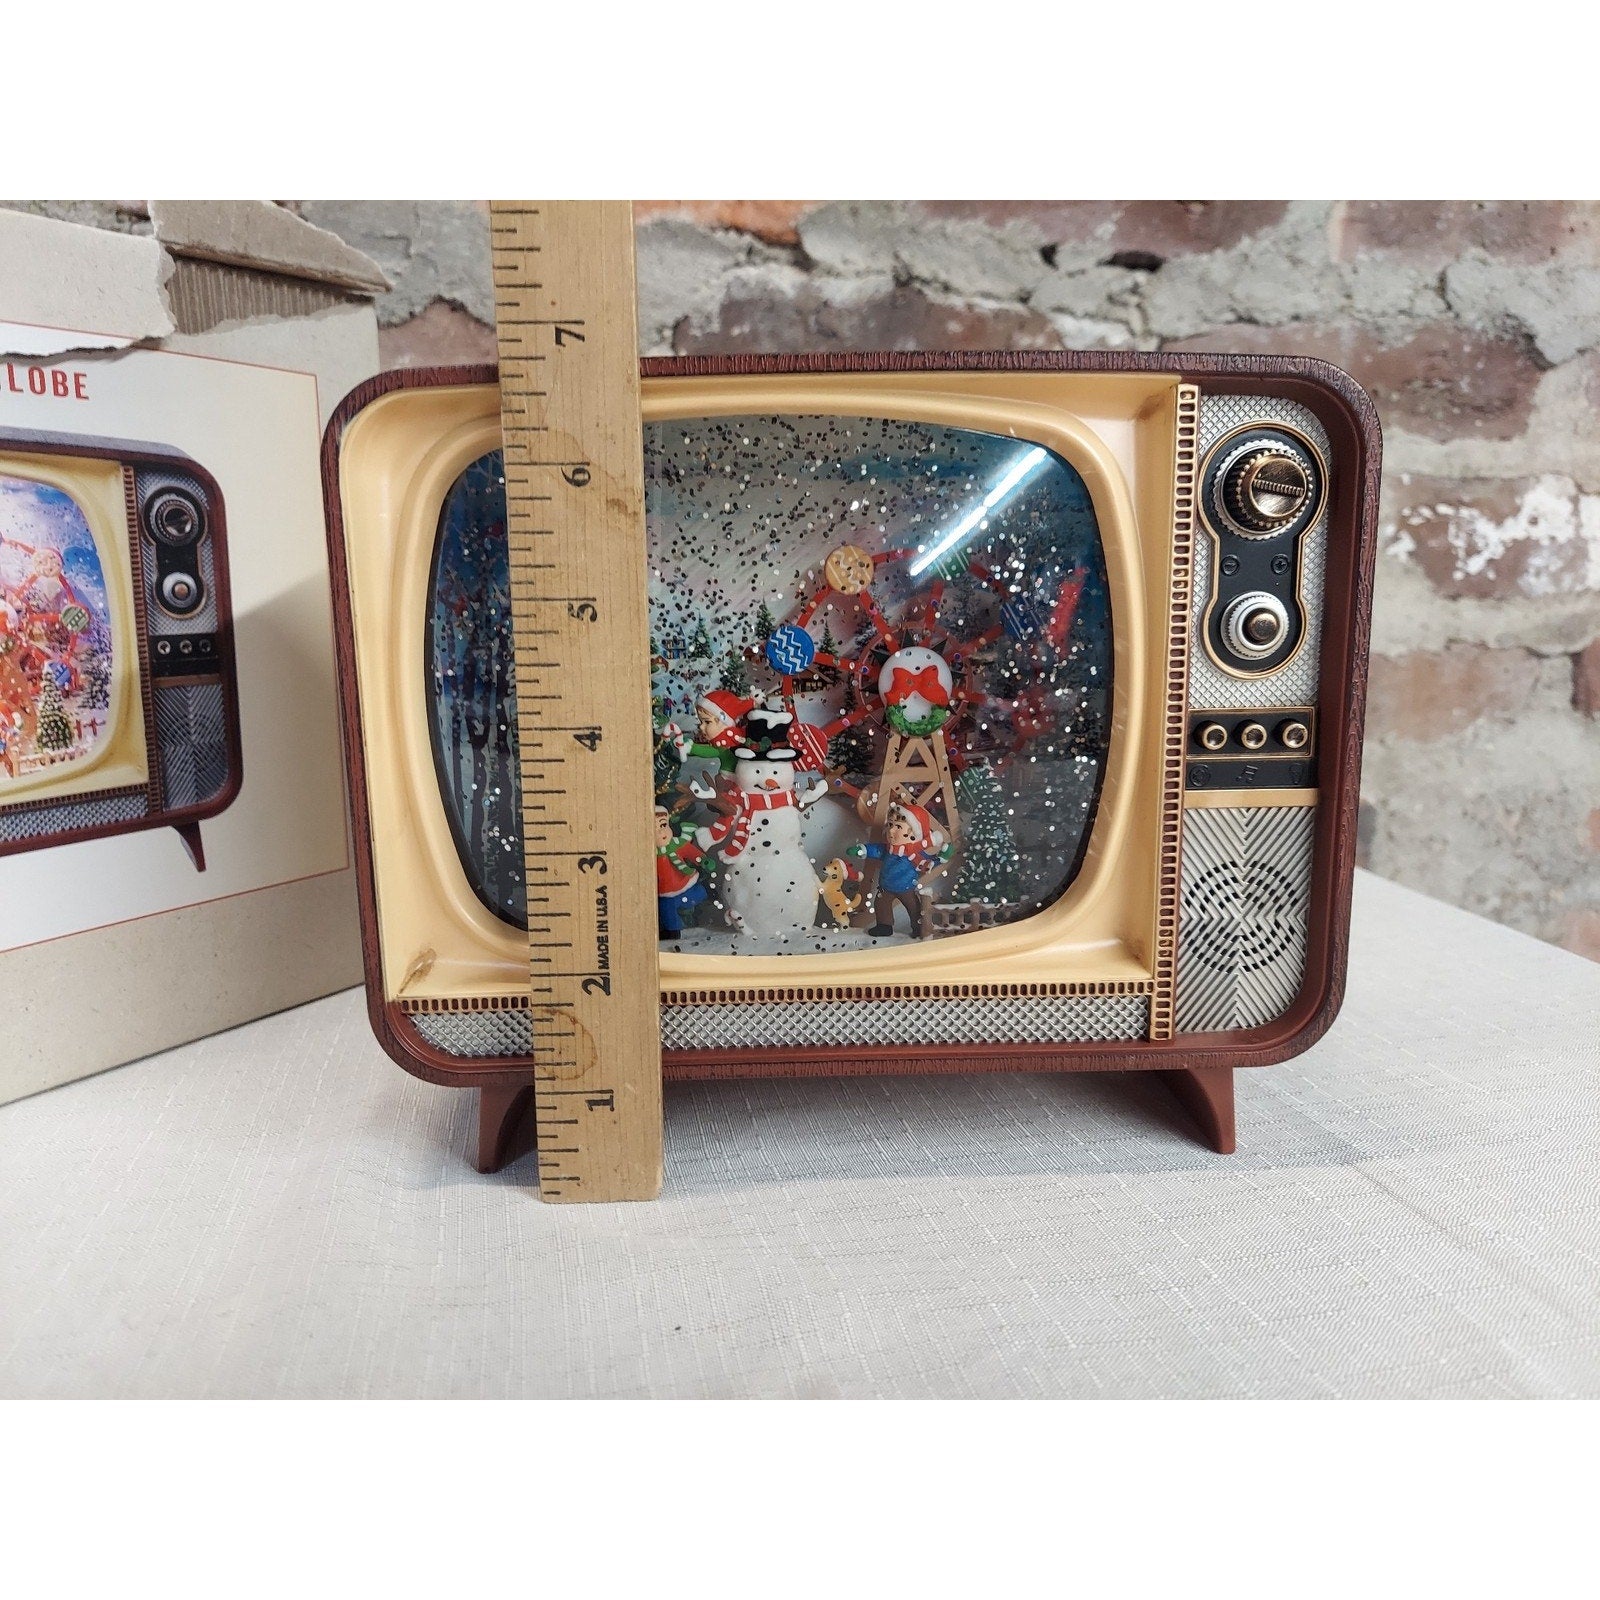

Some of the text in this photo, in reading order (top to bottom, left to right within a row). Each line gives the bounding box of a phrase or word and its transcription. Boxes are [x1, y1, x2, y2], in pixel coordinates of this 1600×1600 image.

[554, 326, 586, 348] 7
[0, 362, 90, 400] LOBE
[561, 466, 592, 487] 6
[566, 602, 598, 623] 5
[573, 731, 603, 752] 4
[578, 855, 608, 875] 3
[596, 919, 609, 933] IN
[597, 935, 610, 970] MADE
[581, 976, 612, 997] 2
[586, 1094, 615, 1112] 1
